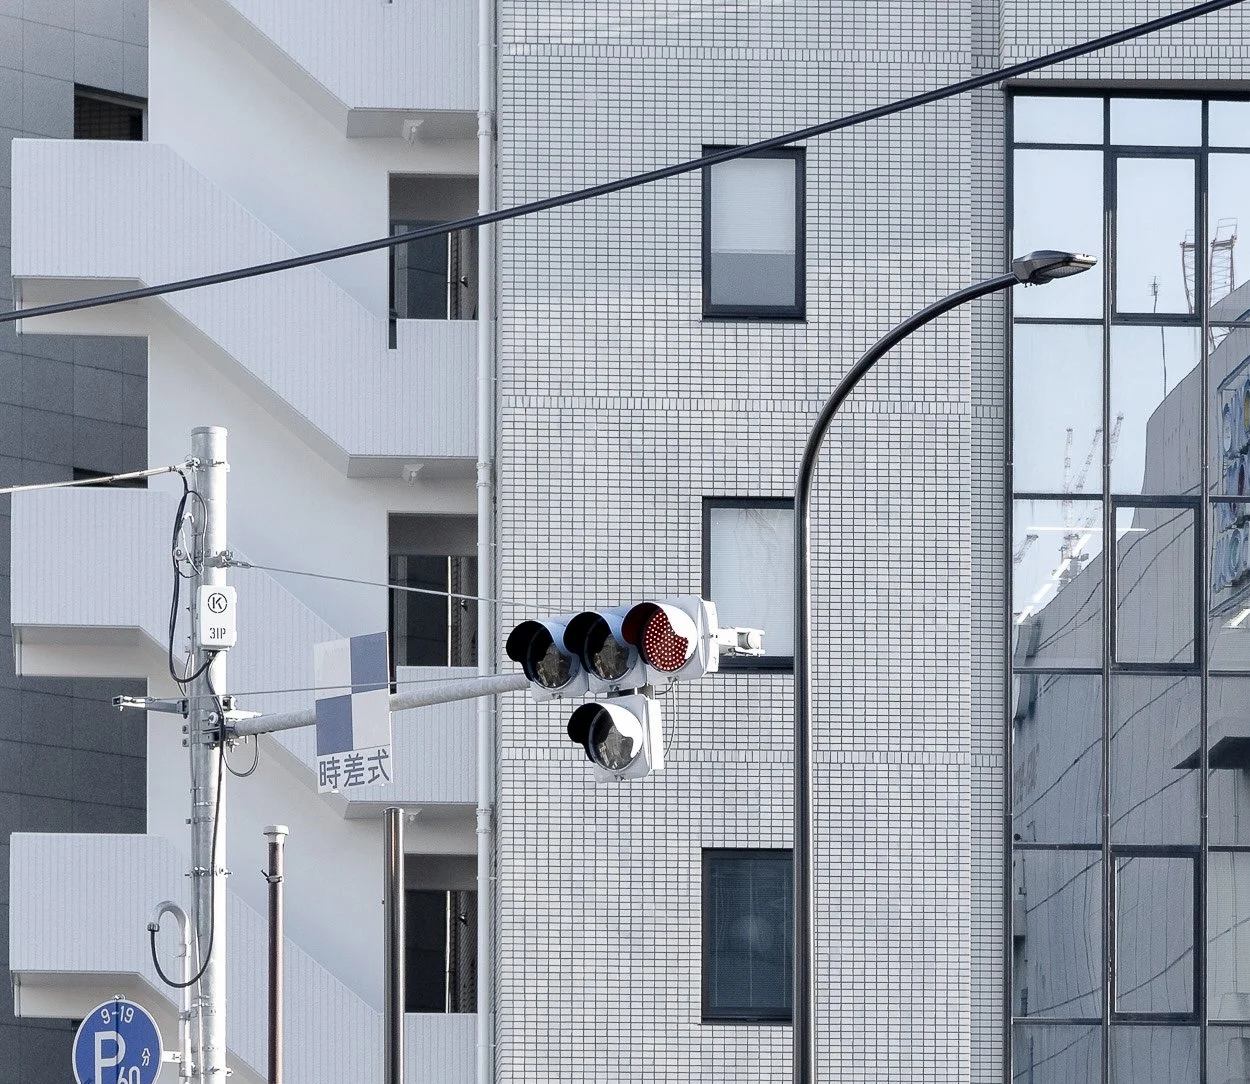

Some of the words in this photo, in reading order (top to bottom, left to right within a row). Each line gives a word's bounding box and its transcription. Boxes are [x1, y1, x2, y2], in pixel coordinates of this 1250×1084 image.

[319, 748, 390, 789] 時差式
[100, 1005, 134, 1024] 9-19
[141, 1047, 151, 1066] 分
